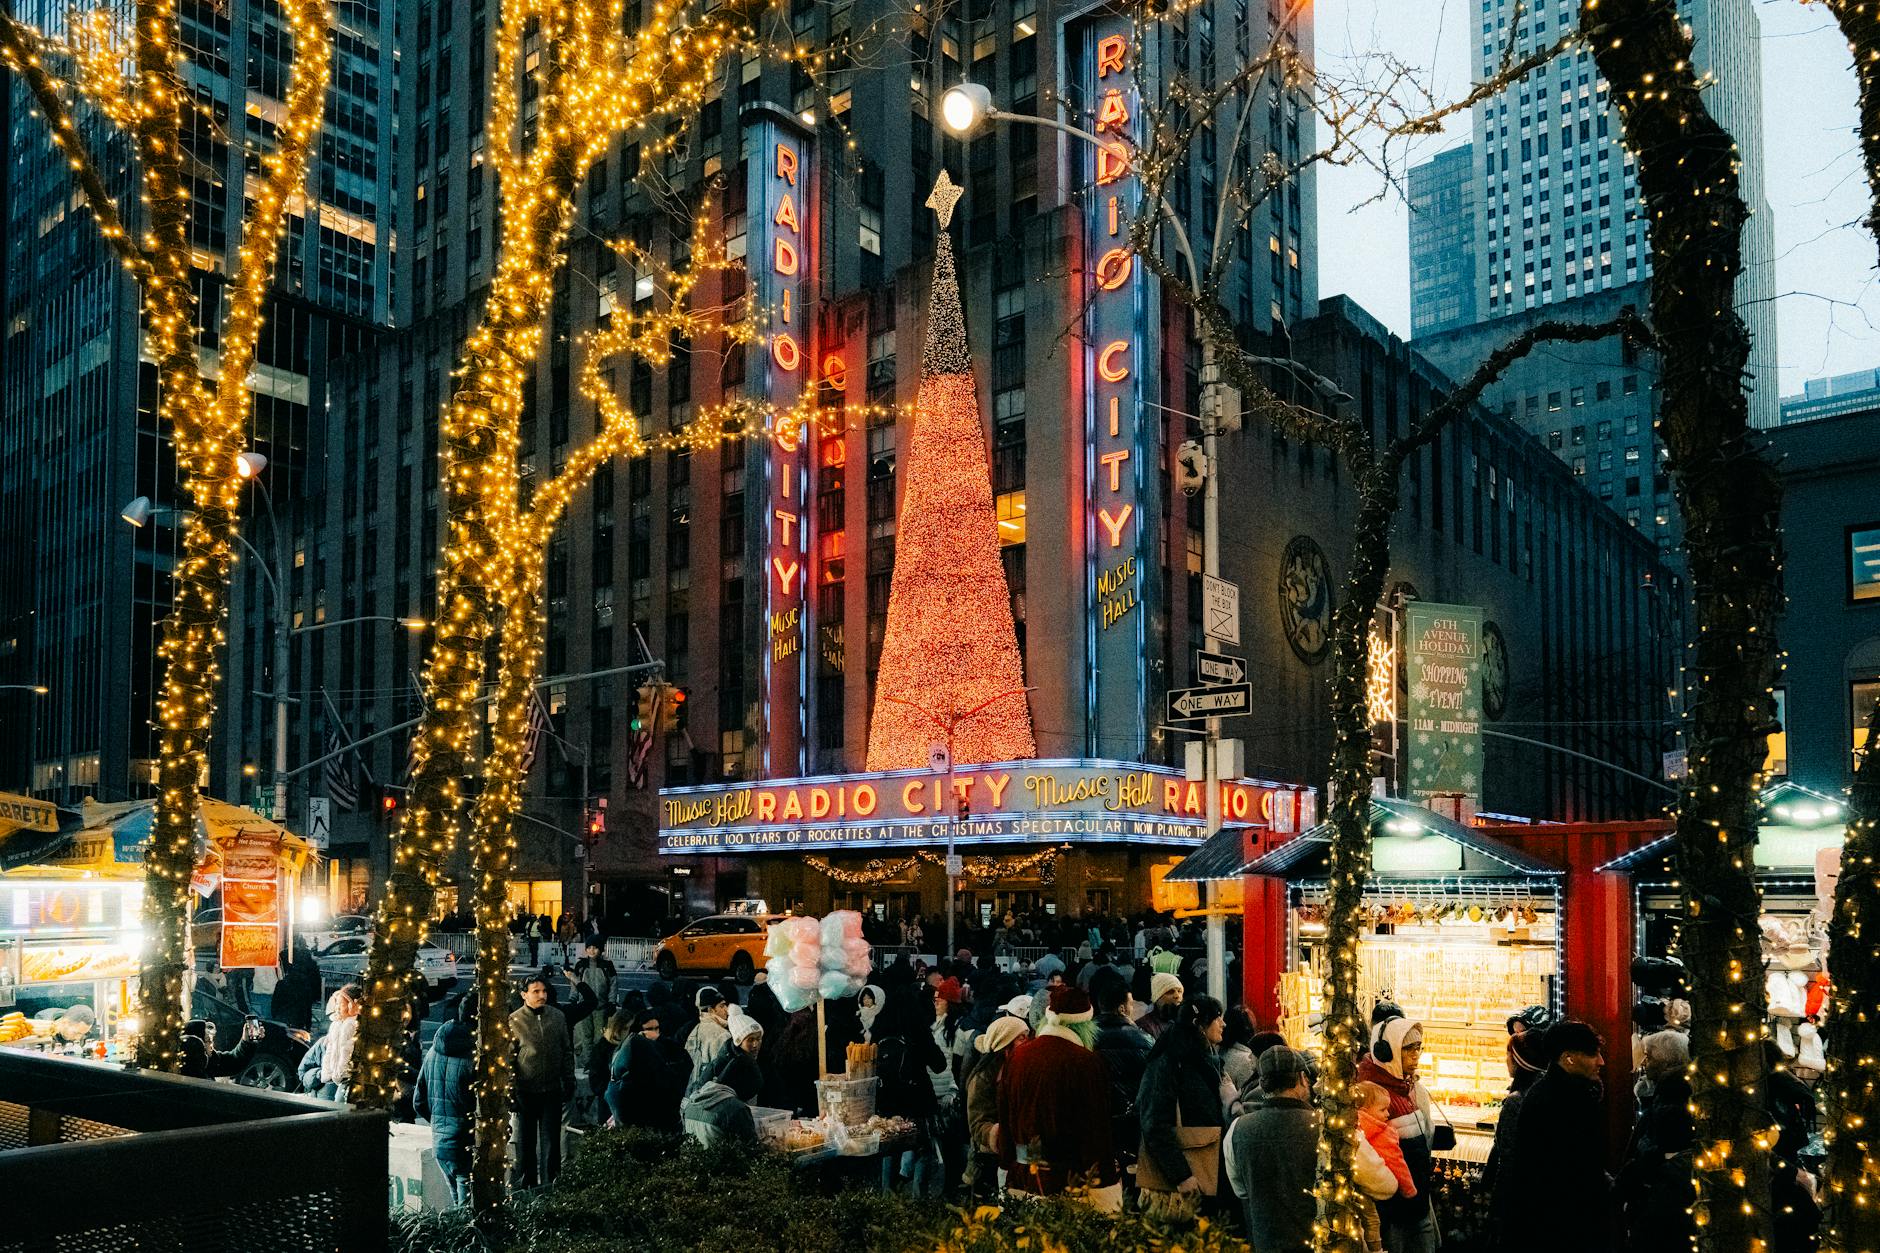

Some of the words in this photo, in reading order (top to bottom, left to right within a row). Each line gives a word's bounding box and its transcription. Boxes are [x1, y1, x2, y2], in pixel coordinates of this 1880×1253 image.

[1097, 34, 1132, 290] RADIO
[774, 143, 800, 372] RADIO
[1099, 341, 1133, 548] CITY
[773, 416, 799, 595] CITY
[1098, 556, 1136, 602] MUSIC
[771, 607, 799, 639] MUSIC
[1102, 590, 1136, 630] HALL
[1423, 630, 1469, 643] AVENUE
[1433, 619, 1457, 630] 6TH
[774, 636, 798, 664] HALL
[1419, 640, 1473, 655] HOLIDAY
[1205, 661, 1219, 676] ONE
[1224, 664, 1239, 678] WAY
[1421, 662, 1469, 688] SHOPPING
[1180, 697, 1202, 711] ONE
[1214, 693, 1239, 707] WAY
[1429, 688, 1463, 710] EVENT!
[1414, 718, 1434, 731] 11AM
[1440, 720, 1479, 734] MIDNIGHT
[257, 807, 266, 818] 50
[665, 799, 711, 827] Music
[709, 789, 753, 827] Hall
[758, 783, 877, 822] RADIO
[903, 773, 1011, 813] CITY
[1025, 775, 1110, 808] Music
[1104, 772, 1153, 812] Hall
[1164, 779, 1248, 818] RAIO
[667, 834, 720, 847] CELEBRATE
[725, 833, 744, 845] 100
[749, 831, 781, 844] YEARS
[787, 831, 801, 843] OF
[808, 828, 872, 842] ROCKETTES
[879, 826, 895, 839] AT
[901, 825, 923, 839] THE
[1134, 821, 1153, 835] NOW
[1157, 824, 1192, 838] PLAYING
[1196, 826, 1208, 838] TH
